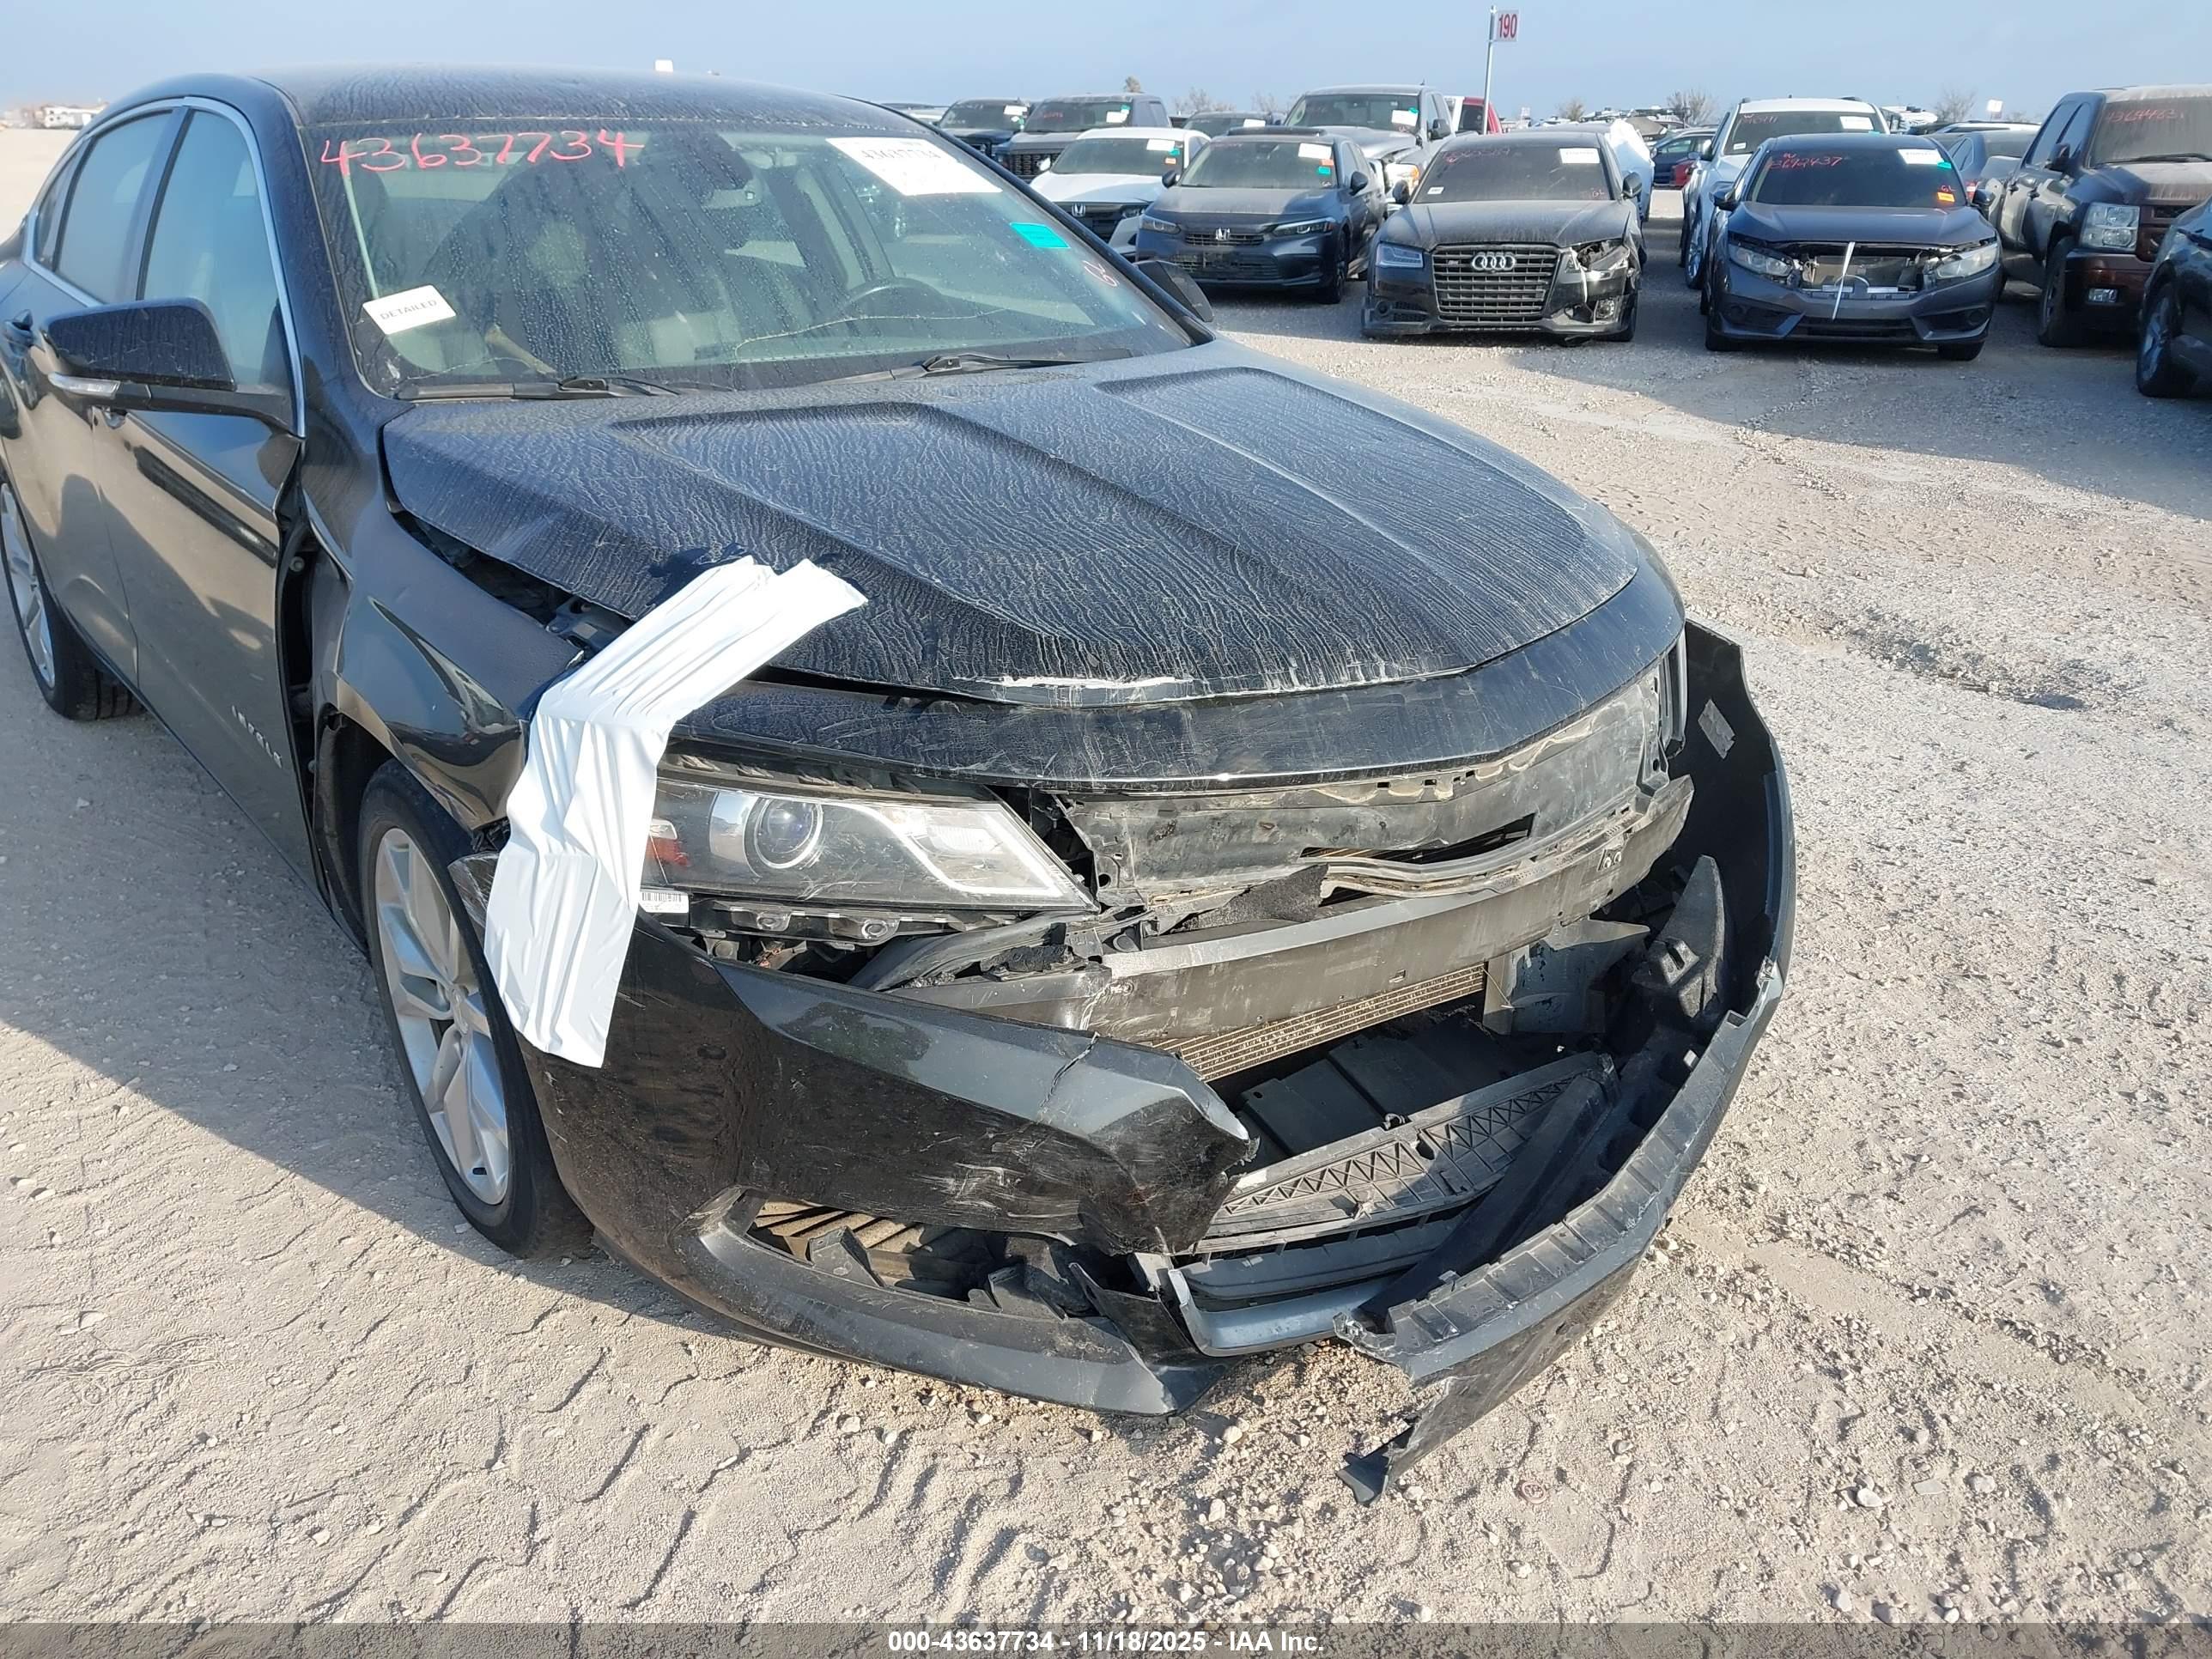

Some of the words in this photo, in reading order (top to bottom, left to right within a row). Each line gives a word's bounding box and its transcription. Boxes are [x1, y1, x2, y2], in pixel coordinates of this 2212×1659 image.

[1498, 13, 1518, 39] 190
[320, 129, 645, 177] 43637734
[380, 299, 438, 320] DETAILED
